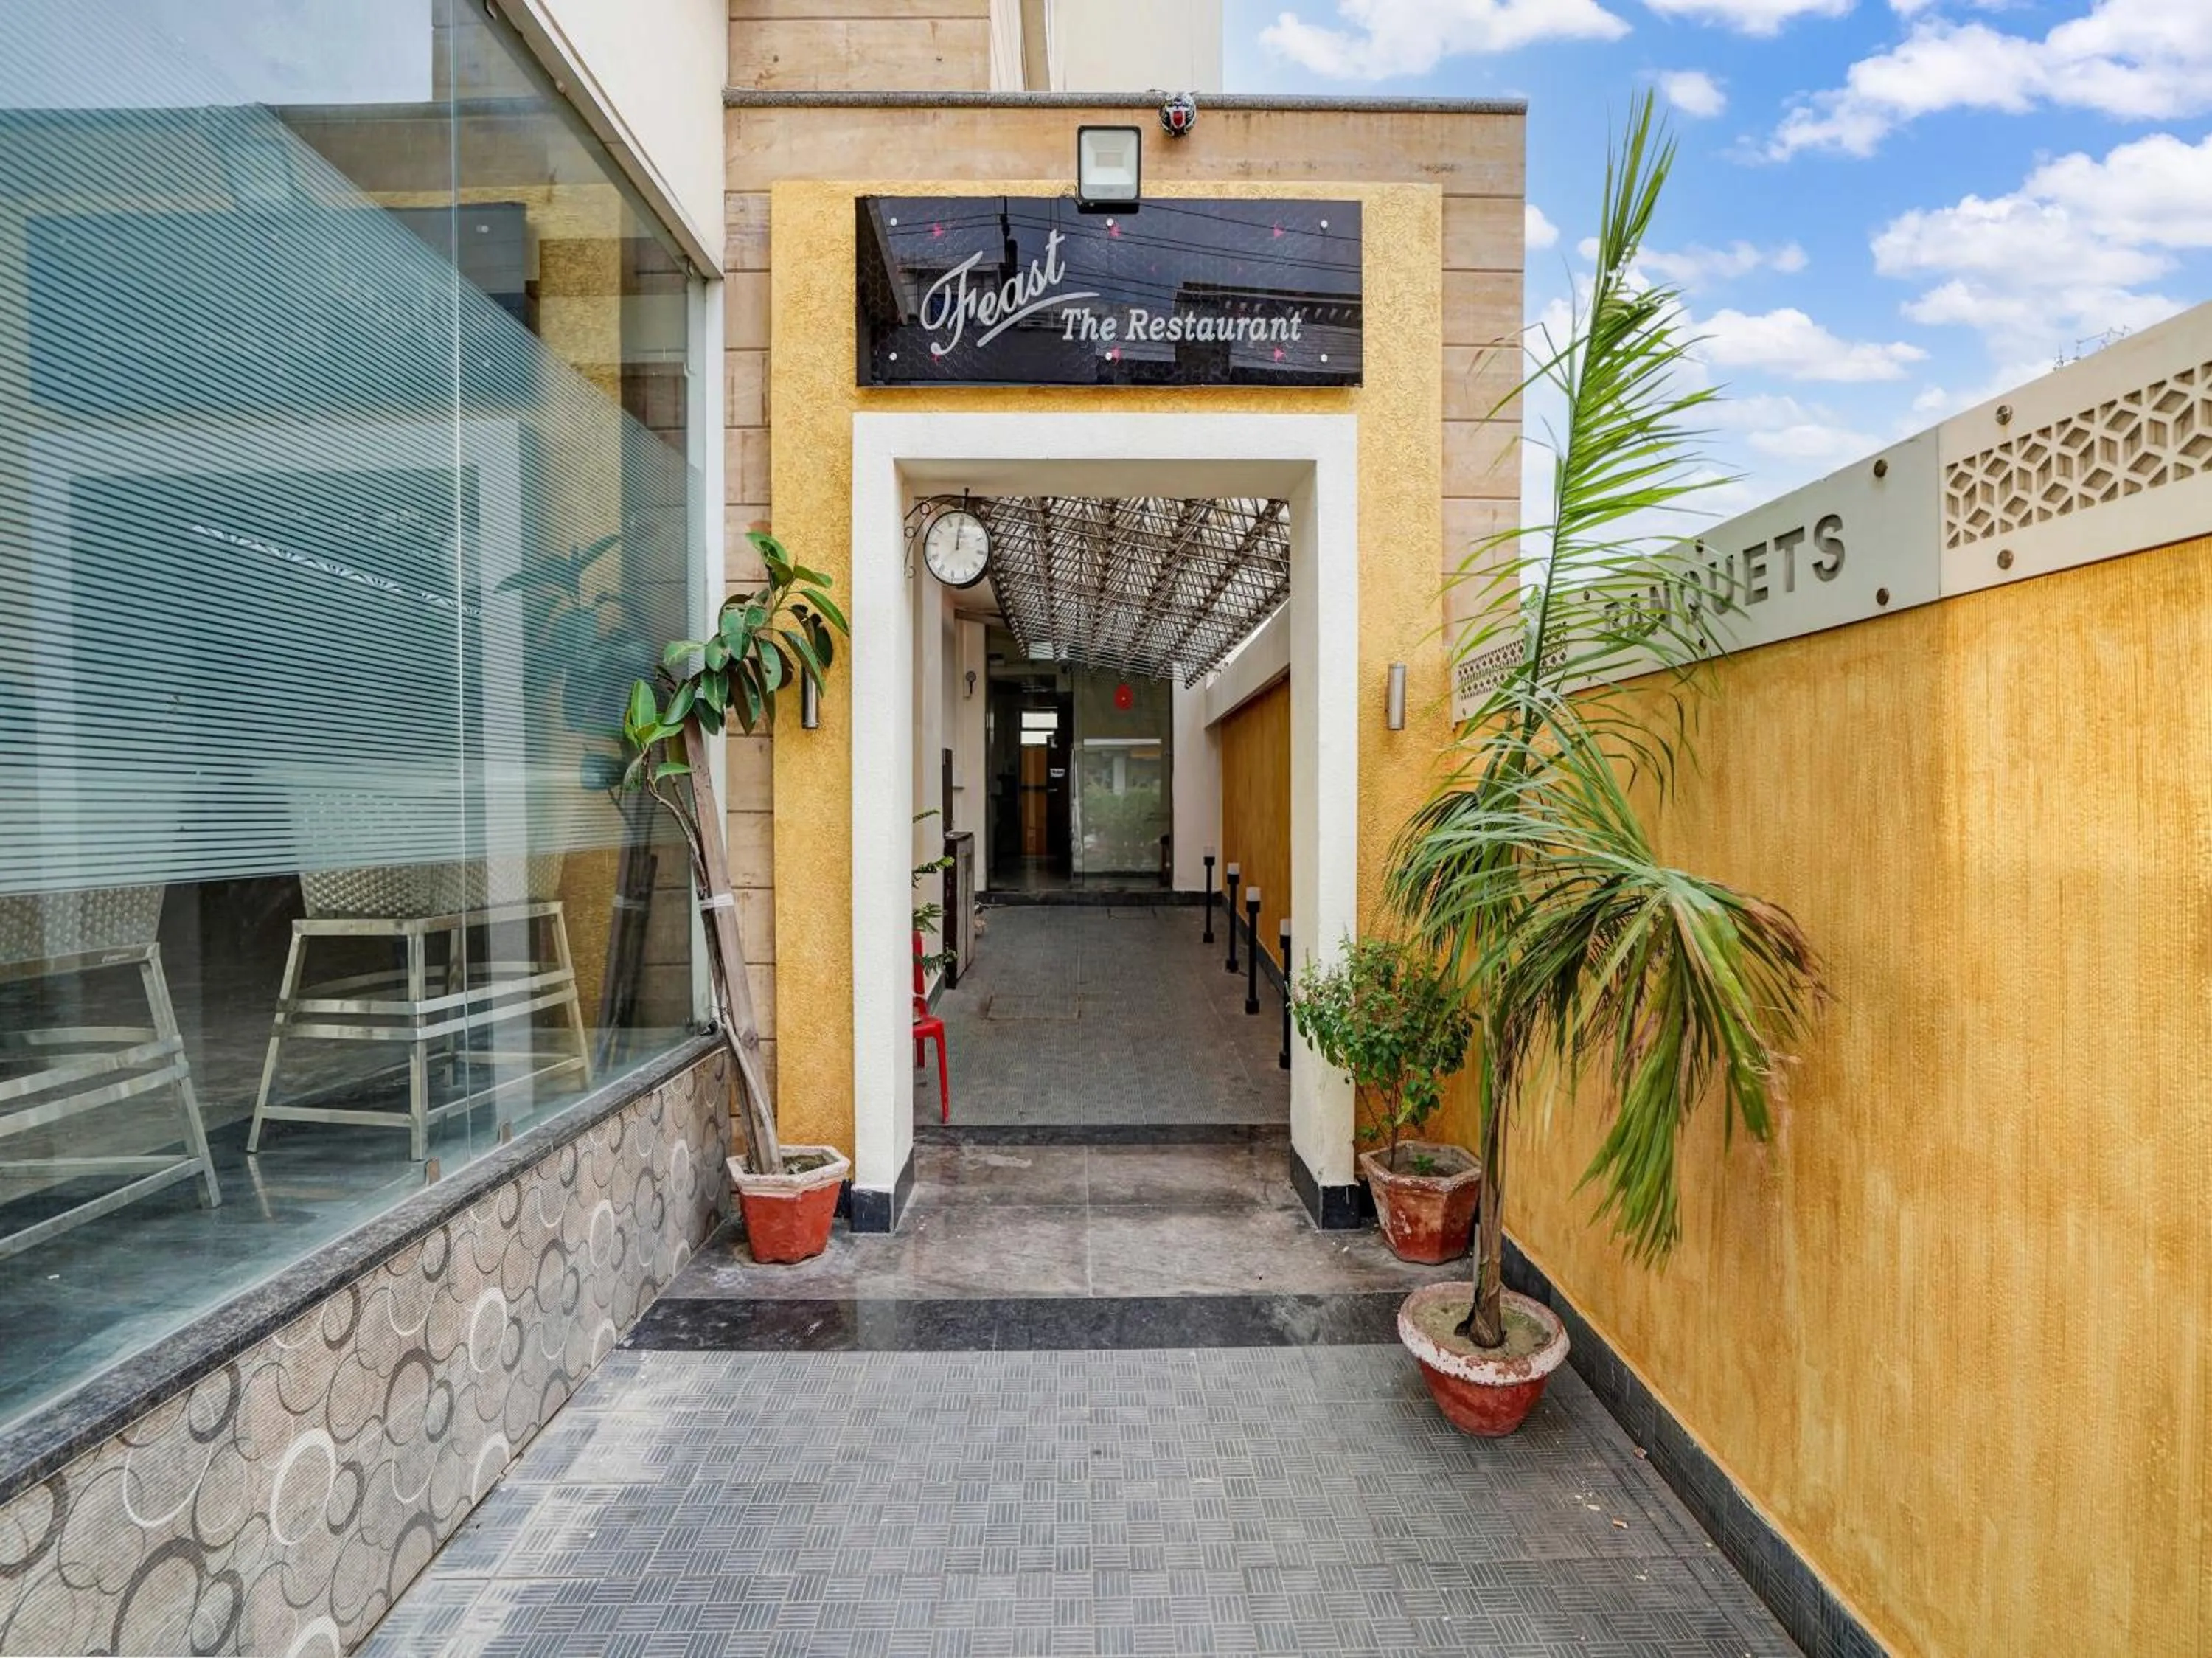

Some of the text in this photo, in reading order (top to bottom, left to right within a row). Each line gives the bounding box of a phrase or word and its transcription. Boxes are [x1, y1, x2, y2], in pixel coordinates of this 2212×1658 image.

[919, 228, 1068, 355] Feast
[1061, 307, 1303, 342] The Restaurant
